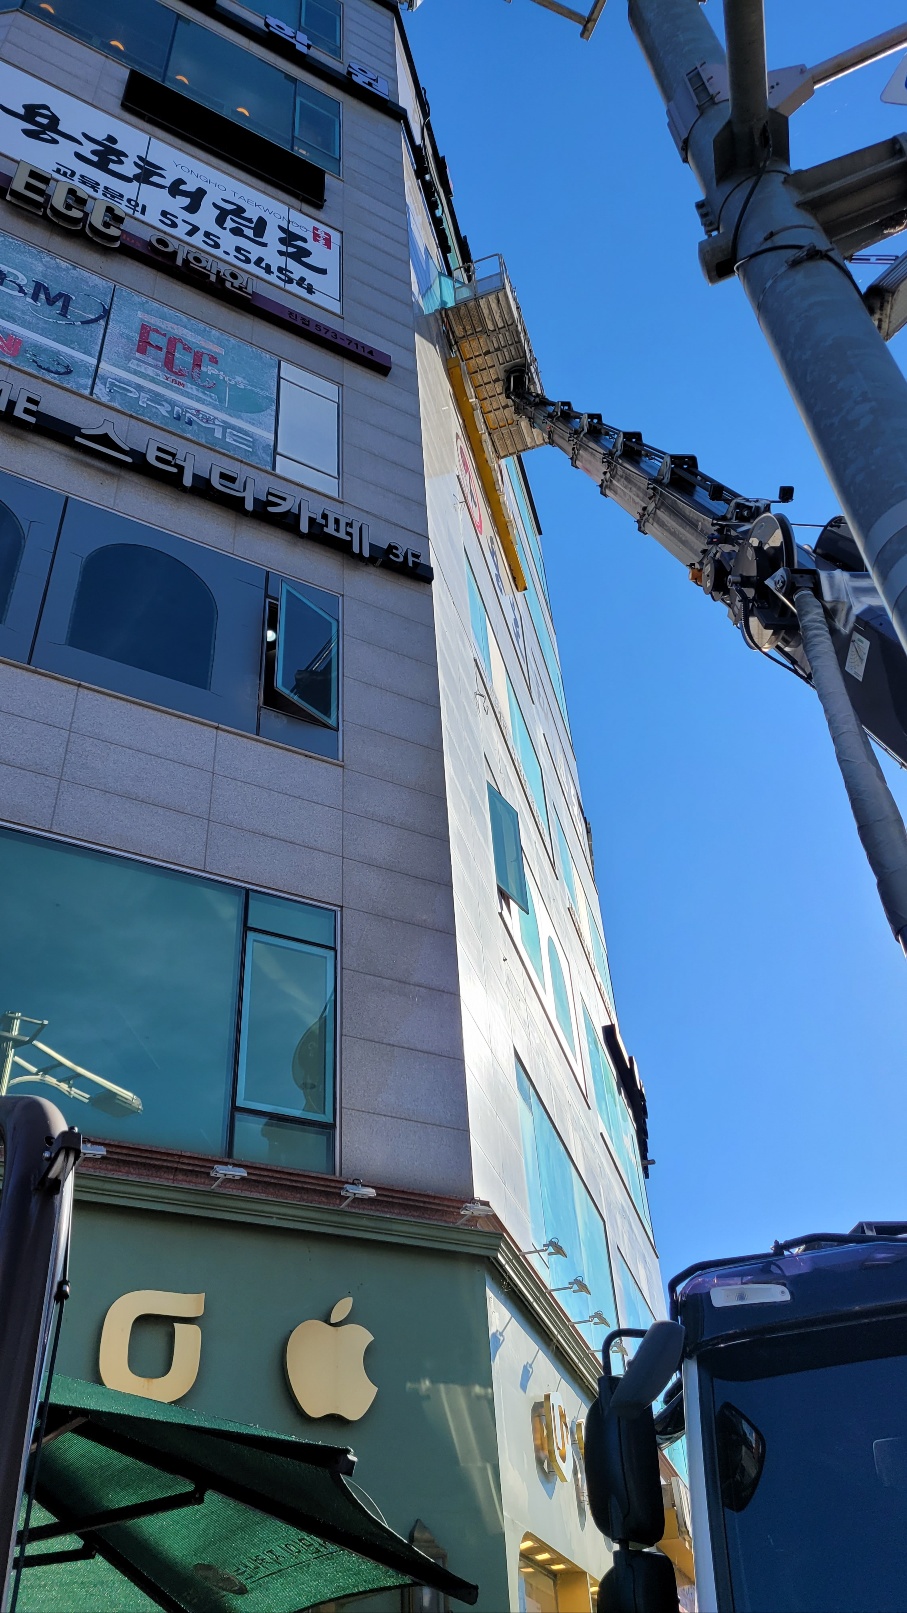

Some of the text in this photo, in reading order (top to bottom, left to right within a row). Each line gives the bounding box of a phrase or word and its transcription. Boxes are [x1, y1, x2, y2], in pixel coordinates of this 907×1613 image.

[6, 159, 126, 247] ECC
[172, 160, 227, 192] YONGHO
[52, 161, 316, 296] 교육문의 575.5454
[314, 323, 375, 357] 573-7114
[74, 418, 371, 558] 스터디카페
[387, 541, 422, 567] 3F
